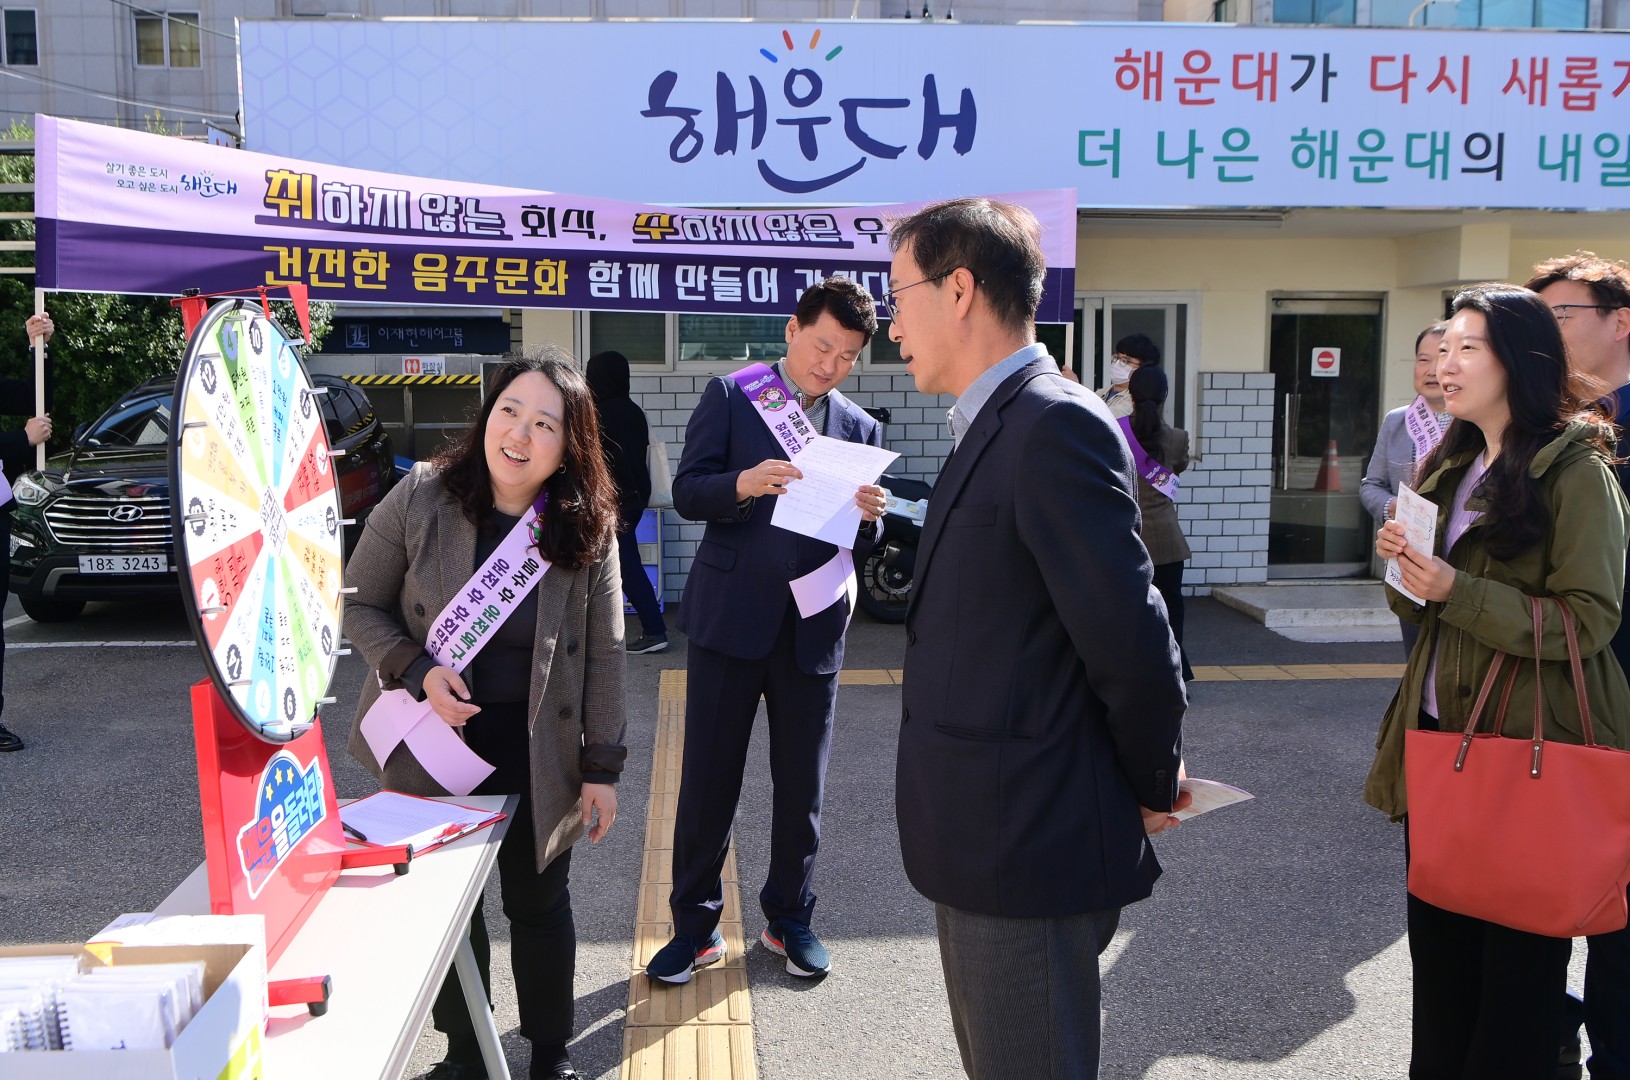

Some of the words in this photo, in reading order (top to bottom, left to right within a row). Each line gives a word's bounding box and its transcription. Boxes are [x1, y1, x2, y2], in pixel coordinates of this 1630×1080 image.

[1114, 48, 1338, 105] 해운대가
[1370, 54, 1470, 105] 다시
[640, 67, 977, 193] 해운대
[106, 162, 125, 174] 살기
[128, 165, 146, 177] 좋은
[150, 168, 168, 179] 도시
[1078, 128, 1120, 178] 더
[1157, 127, 1259, 182] 나은
[1291, 127, 1504, 183] 해운대의
[116, 179, 135, 189] 오고
[138, 182, 156, 193] 싶은
[160, 184, 178, 194] 도시
[180, 174, 237, 198] 해운대
[264, 168, 409, 231] 취하지
[420, 193, 504, 236] 않는
[521, 204, 607, 241] 회식,
[764, 213, 842, 243] 않은
[264, 245, 390, 290] 건전한
[412, 252, 568, 296] 음주문화
[588, 260, 660, 300] 함께
[675, 264, 778, 304] 만들어
[87, 557, 115, 571] 18조
[122, 557, 160, 570] 3243
[480, 558, 510, 590] 운전
[511, 557, 540, 588] 음주
[467, 588, 485, 605] 후
[498, 586, 516, 604] 후
